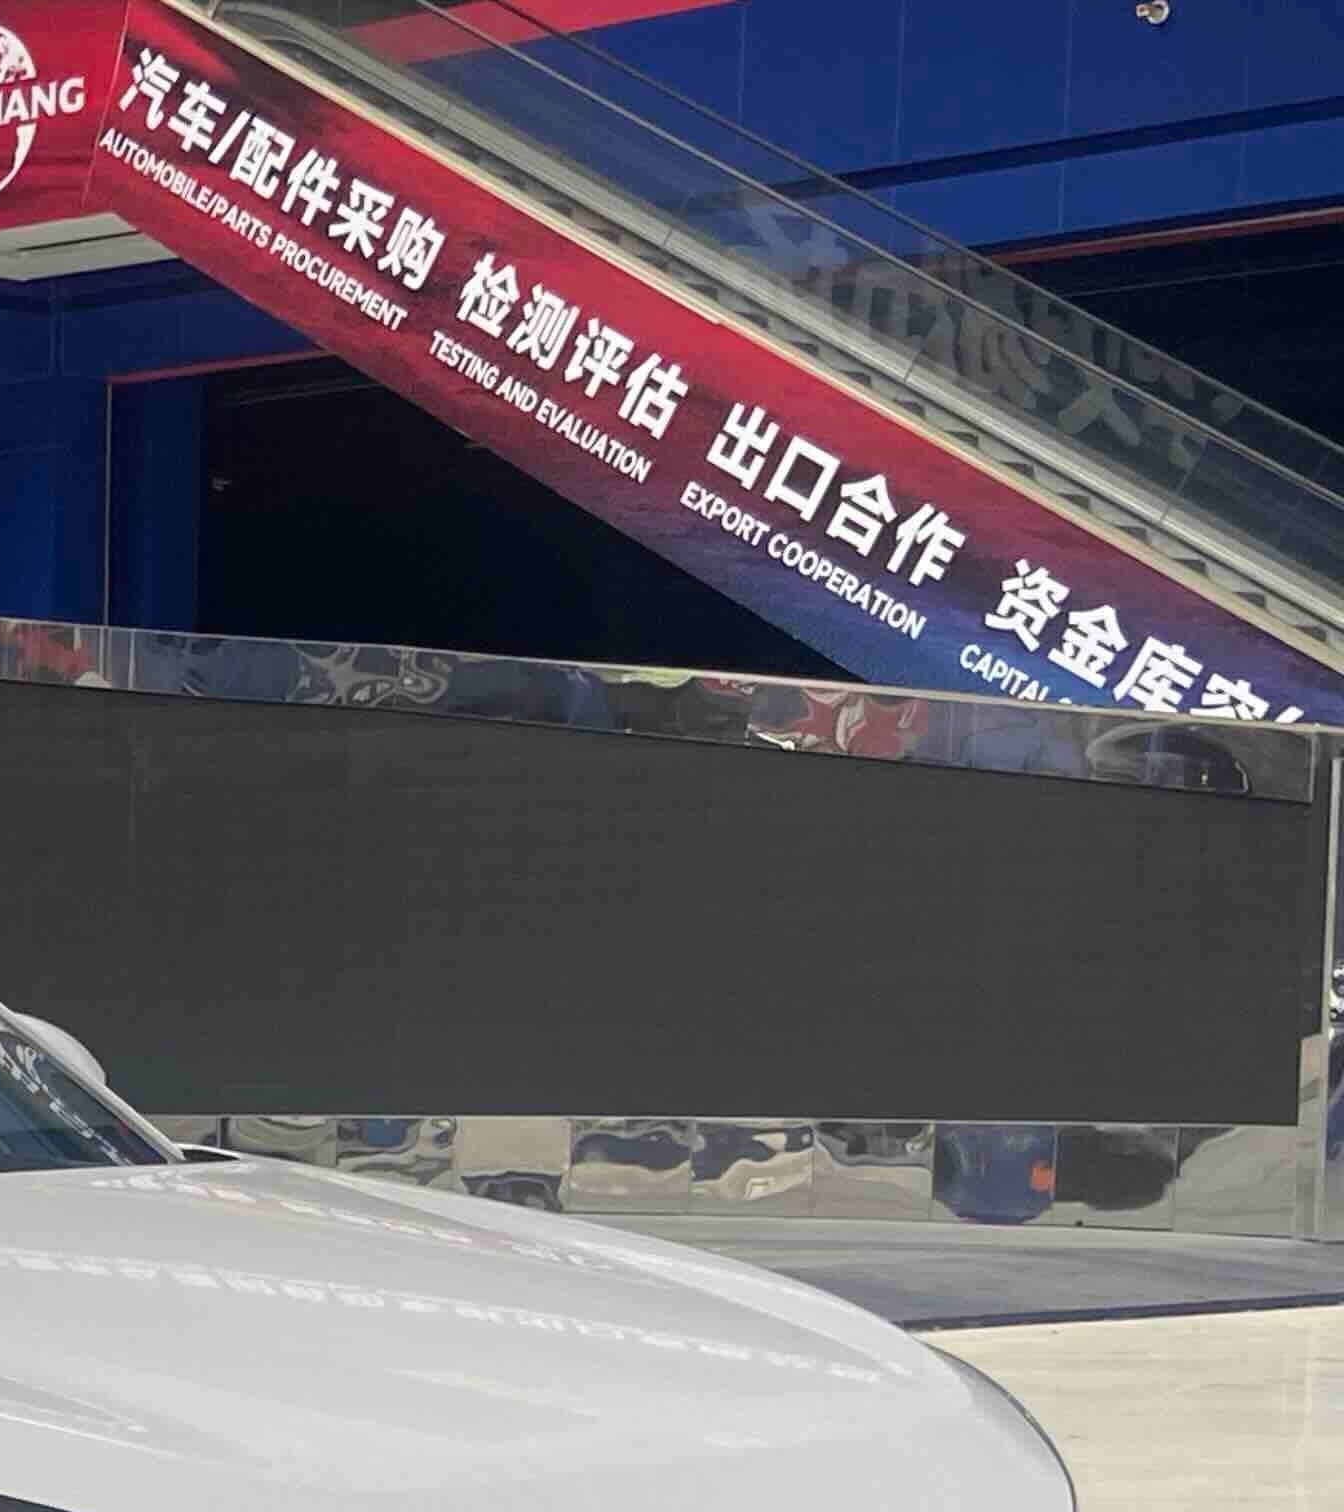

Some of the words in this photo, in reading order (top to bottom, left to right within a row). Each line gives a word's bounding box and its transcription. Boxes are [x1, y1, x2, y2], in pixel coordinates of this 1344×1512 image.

[98, 128, 272, 249] AUTOMOBILE/PARTS
[269, 232, 408, 331] PROCUREMENT
[428, 331, 499, 389] TESTING
[495, 375, 539, 413] AND
[535, 399, 652, 484] EVALUATION
[680, 481, 770, 547] EXPORT
[767, 533, 926, 639] COOPERATION
[119, 48, 446, 291] 汽车/配件采购
[457, 252, 689, 440] 检测评估
[706, 402, 966, 586] 出口合作
